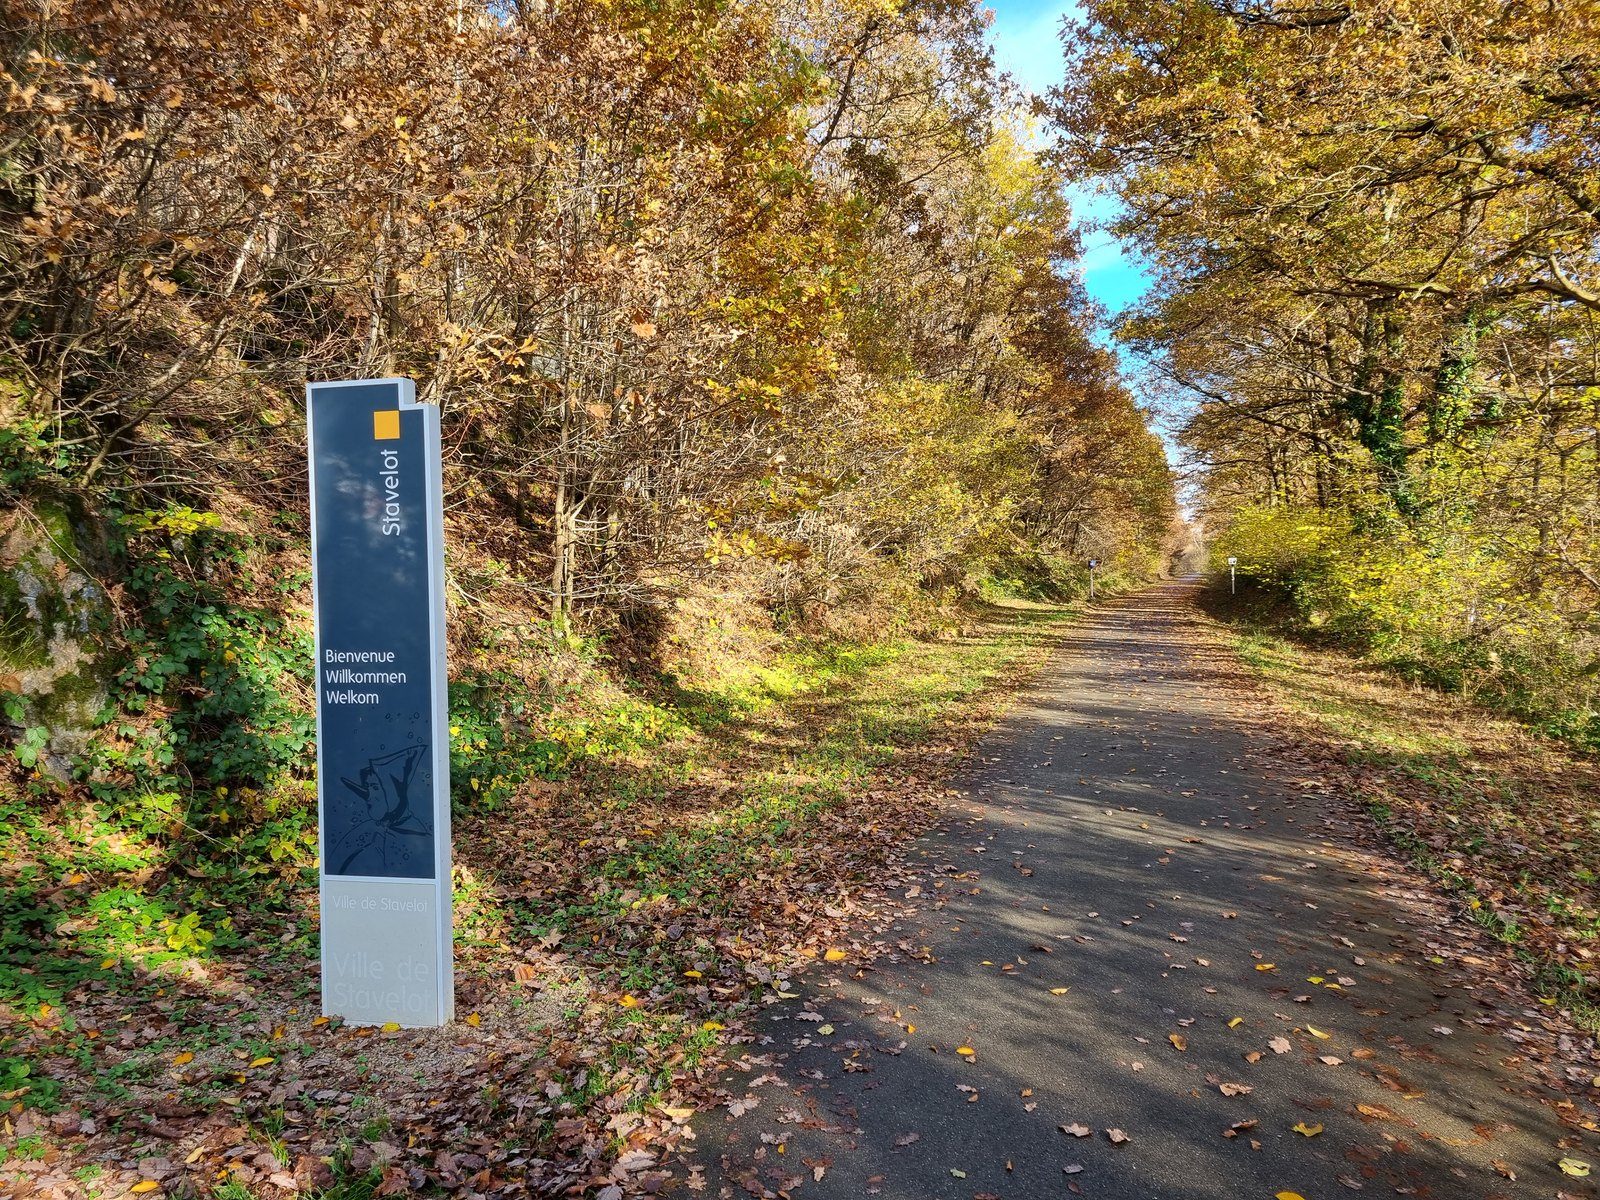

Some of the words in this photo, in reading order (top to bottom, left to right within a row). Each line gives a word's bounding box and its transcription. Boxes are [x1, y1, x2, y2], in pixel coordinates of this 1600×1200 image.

[380, 449, 400, 536] Stavelot
[325, 649, 396, 663] Bienvenue
[325, 669, 407, 684] Willkommen
[326, 690, 379, 705] Welkom
[332, 895, 357, 909] Ville
[360, 896, 377, 910] de
[380, 897, 428, 912] Stavelot
[333, 952, 384, 980] Ville
[398, 955, 429, 982] de
[334, 982, 432, 1013] Stavelot
